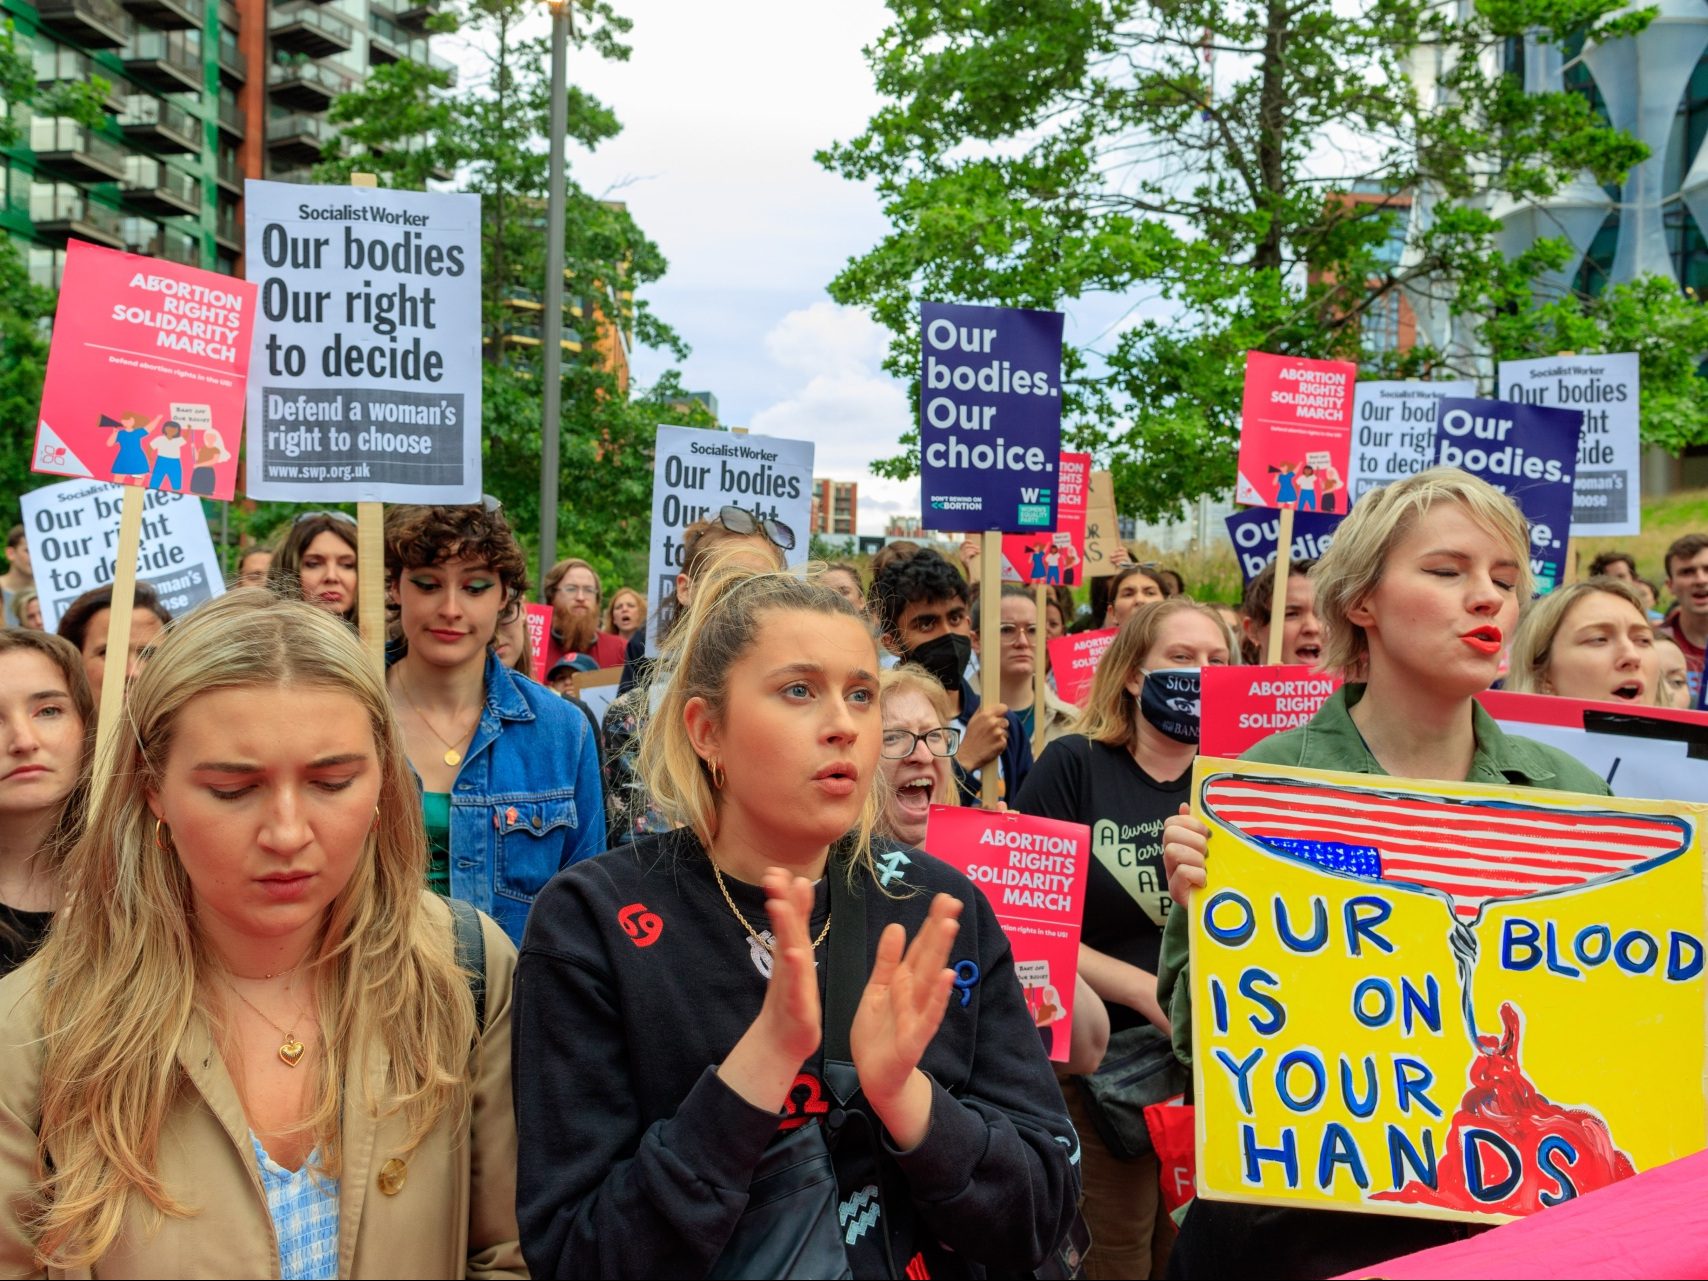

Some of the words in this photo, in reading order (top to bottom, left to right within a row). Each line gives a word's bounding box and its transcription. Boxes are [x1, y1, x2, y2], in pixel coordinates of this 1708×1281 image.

[299, 204, 368, 222] Socialist
[369, 206, 429, 228] Worker
[262, 222, 330, 269] Our
[343, 225, 465, 277] bodies
[129, 272, 243, 312] ABORTION
[262, 277, 331, 323] Our
[346, 279, 436, 335] right
[112, 304, 240, 345] SOLIDARITY
[163, 296, 241, 328] RIGHTS
[156, 330, 236, 363] MARCH
[927, 318, 997, 353] Our
[265, 333, 306, 377] to
[322, 332, 444, 382] decide
[139, 361, 173, 375] abortion
[174, 368, 197, 380] rights
[197, 374, 205, 382] in
[927, 356, 1058, 397] bodies.
[1278, 368, 1346, 385] ABORTION
[1530, 366, 1572, 379] Socialist
[1573, 365, 1605, 376] Worker
[1271, 390, 1344, 409] SOLIDARITY
[1299, 381, 1345, 397] RIGHTS
[1509, 383, 1549, 406] Our
[1558, 378, 1627, 403] bodies
[268, 394, 342, 422] Defend
[349, 401, 362, 423] a
[368, 399, 457, 426] woman's
[927, 397, 997, 431] Our
[1296, 405, 1344, 421] MARCH
[1361, 400, 1394, 421] Our
[1401, 400, 1437, 422] bod
[1443, 409, 1513, 441] Our
[268, 426, 321, 457] right
[328, 428, 351, 452] to
[357, 426, 432, 454] choose
[690, 441, 739, 458] Socialist
[739, 446, 779, 463] Worker
[926, 435, 1053, 472] choice.
[1359, 425, 1393, 447] Our
[1400, 426, 1437, 454] righ
[268, 462, 371, 480] www.swp.org.uk
[1059, 461, 1084, 473] TION
[1358, 452, 1378, 473] to
[1439, 439, 1571, 484] bodies.
[665, 455, 711, 490] Our
[720, 460, 801, 499] bodies
[57, 483, 108, 503] Socialist
[1573, 491, 1608, 507] hoose
[35, 506, 84, 533] Our
[1235, 518, 1280, 548] Ou
[41, 536, 93, 562] Our
[103, 513, 172, 551] riht
[50, 567, 82, 592] to
[153, 569, 202, 595] man's
[1166, 675, 1201, 693] SIOU
[1248, 680, 1333, 696] ABORTION
[1276, 696, 1328, 712] RIGHT
[979, 828, 1077, 856] ABORTION
[1008, 851, 1076, 875] RIGHTS
[966, 864, 1075, 893] SOLIDARITY
[1002, 887, 1071, 912] MARCH
[1017, 925, 1037, 935] rights
[1203, 890, 1395, 957] OUR
[1501, 917, 1706, 981] BLOOD
[1210, 967, 1287, 1036] IS
[1352, 973, 1442, 1036] ON
[1215, 1046, 1444, 1118] YOUR
[1242, 1122, 1578, 1208] HANDS
